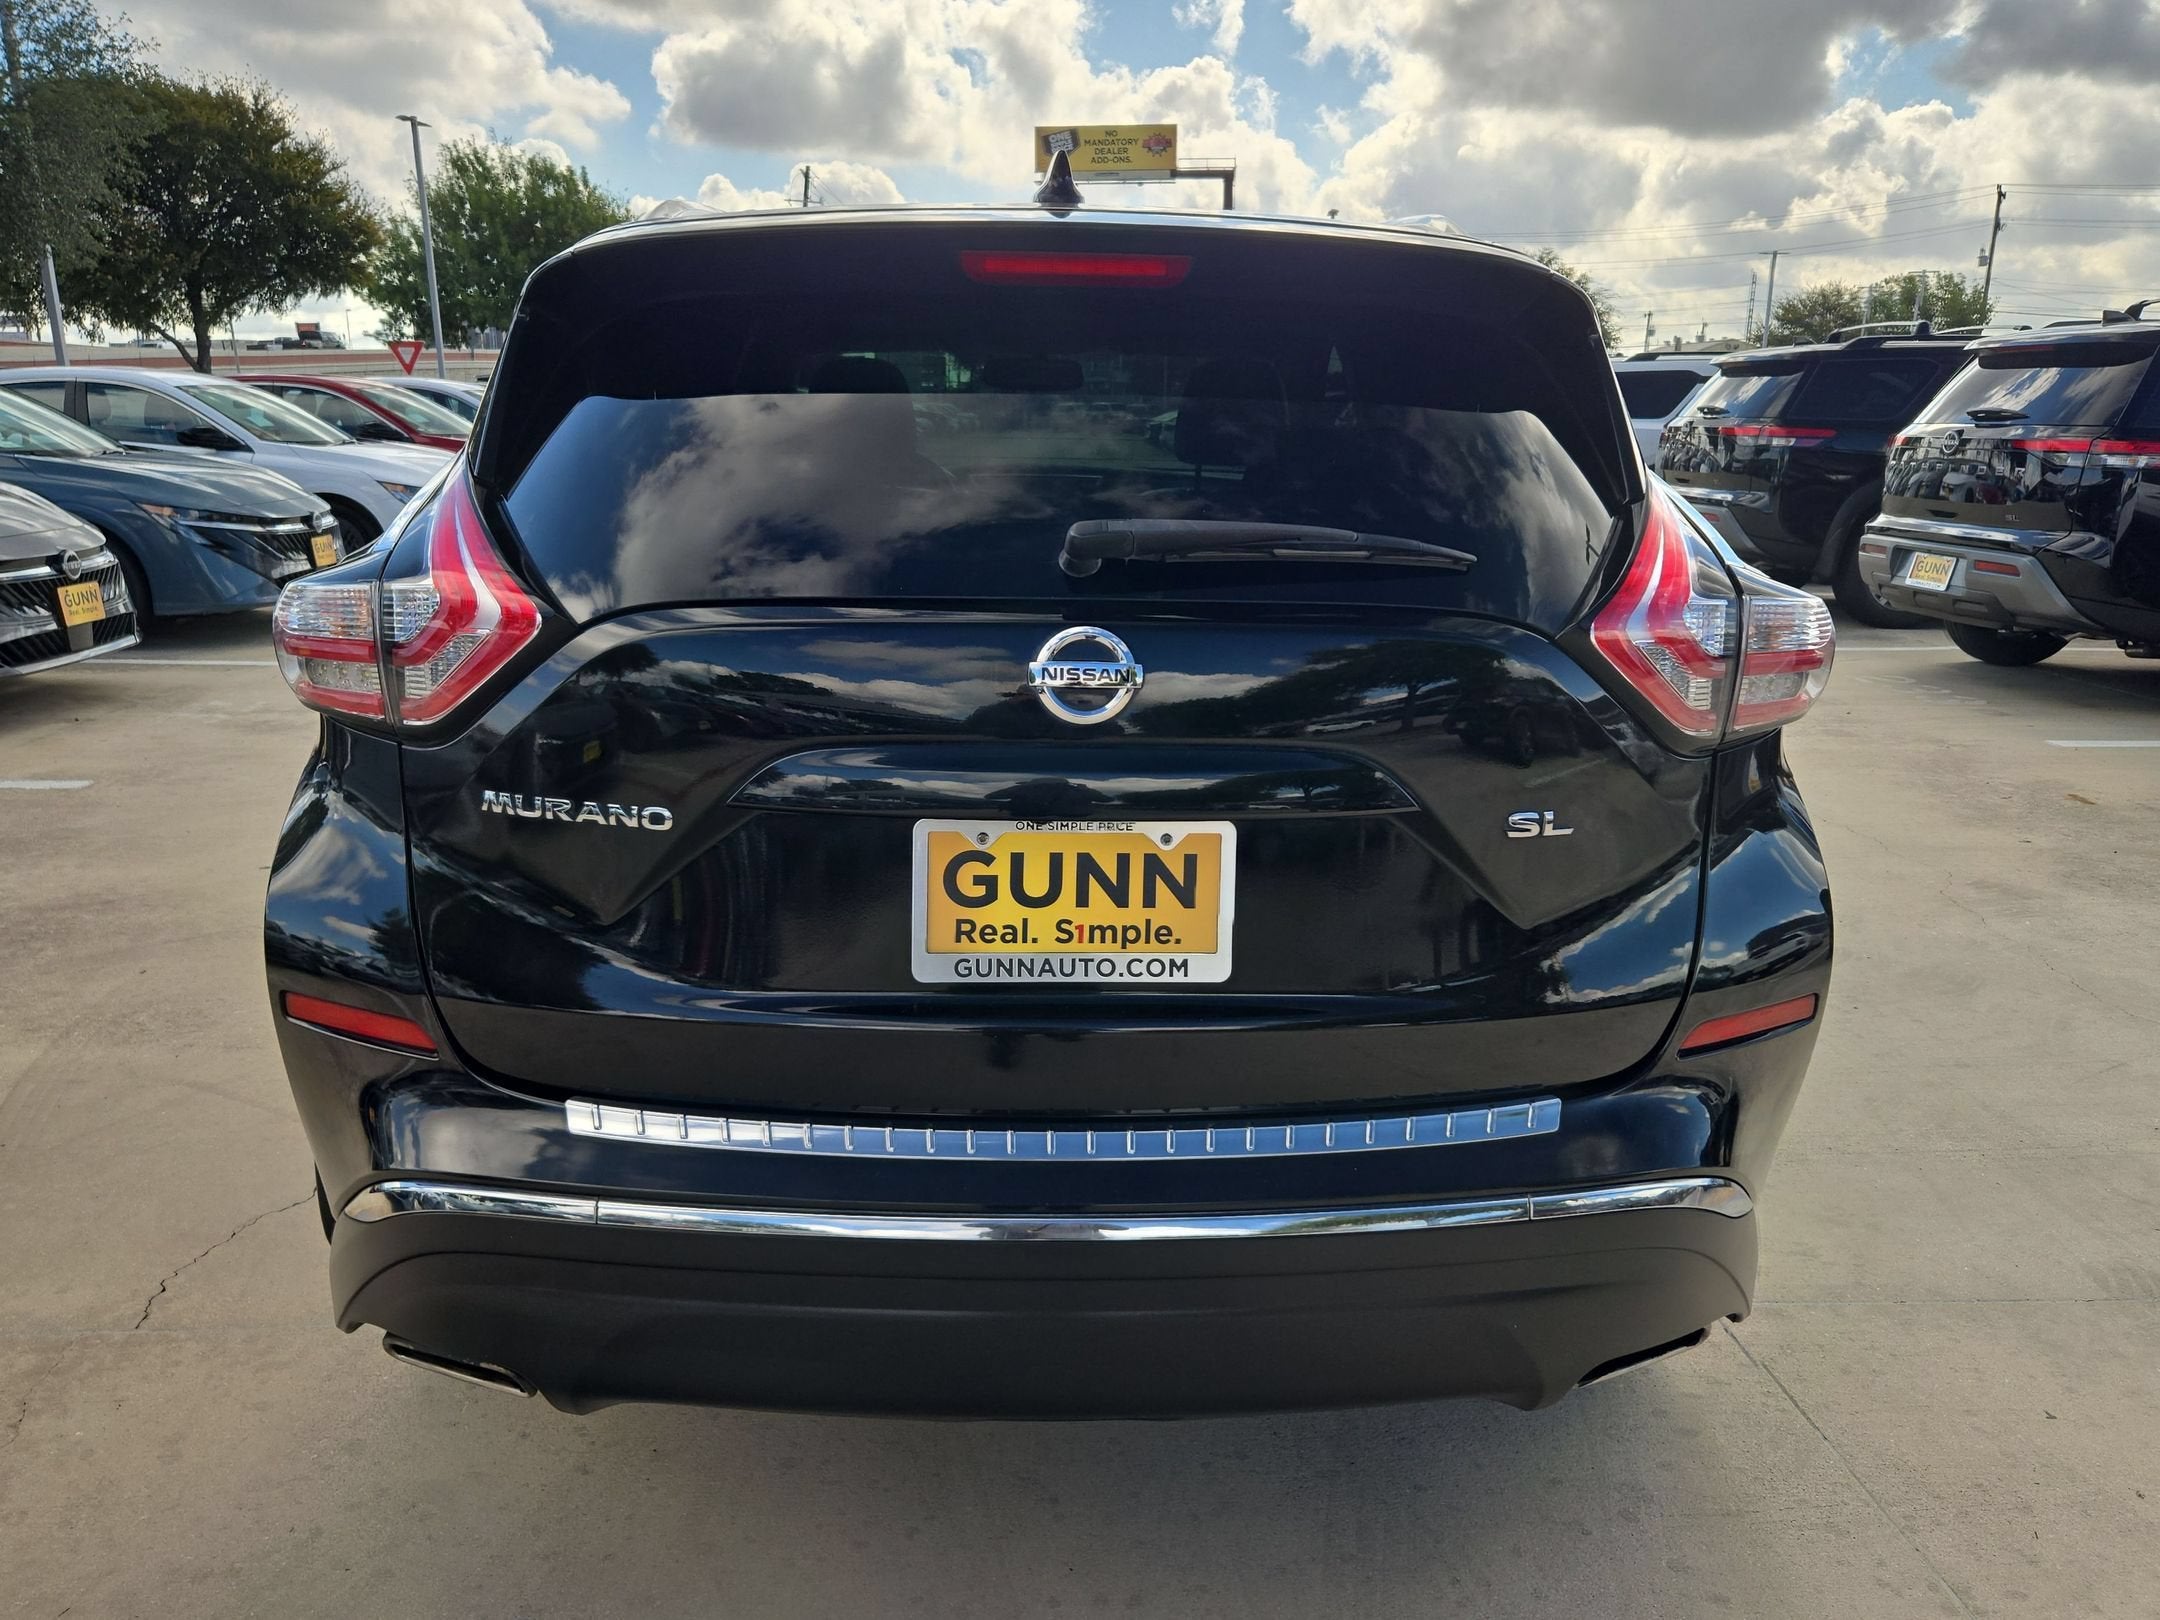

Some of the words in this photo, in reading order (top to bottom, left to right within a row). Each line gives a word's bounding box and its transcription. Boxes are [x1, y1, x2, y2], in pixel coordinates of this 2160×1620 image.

[1049, 131, 1072, 143] ONE
[1084, 138, 1139, 146] MANDATORY
[1095, 147, 1129, 155] DEALER
[1091, 156, 1133, 164] ADD-ONS.
[2005, 514, 2019, 522] SL
[1916, 560, 1951, 577] GUNN
[64, 589, 99, 608] GUNN
[1041, 667, 1130, 682] NISSAN
[481, 790, 673, 831] MURANO
[1015, 821, 1043, 831] ONE
[1047, 821, 1094, 831] SIMPLE
[1506, 811, 1574, 838] SL
[943, 850, 1198, 909] GUNN
[954, 918, 1038, 944] Real.
[954, 958, 1189, 978] GUNNAUTO.COM
